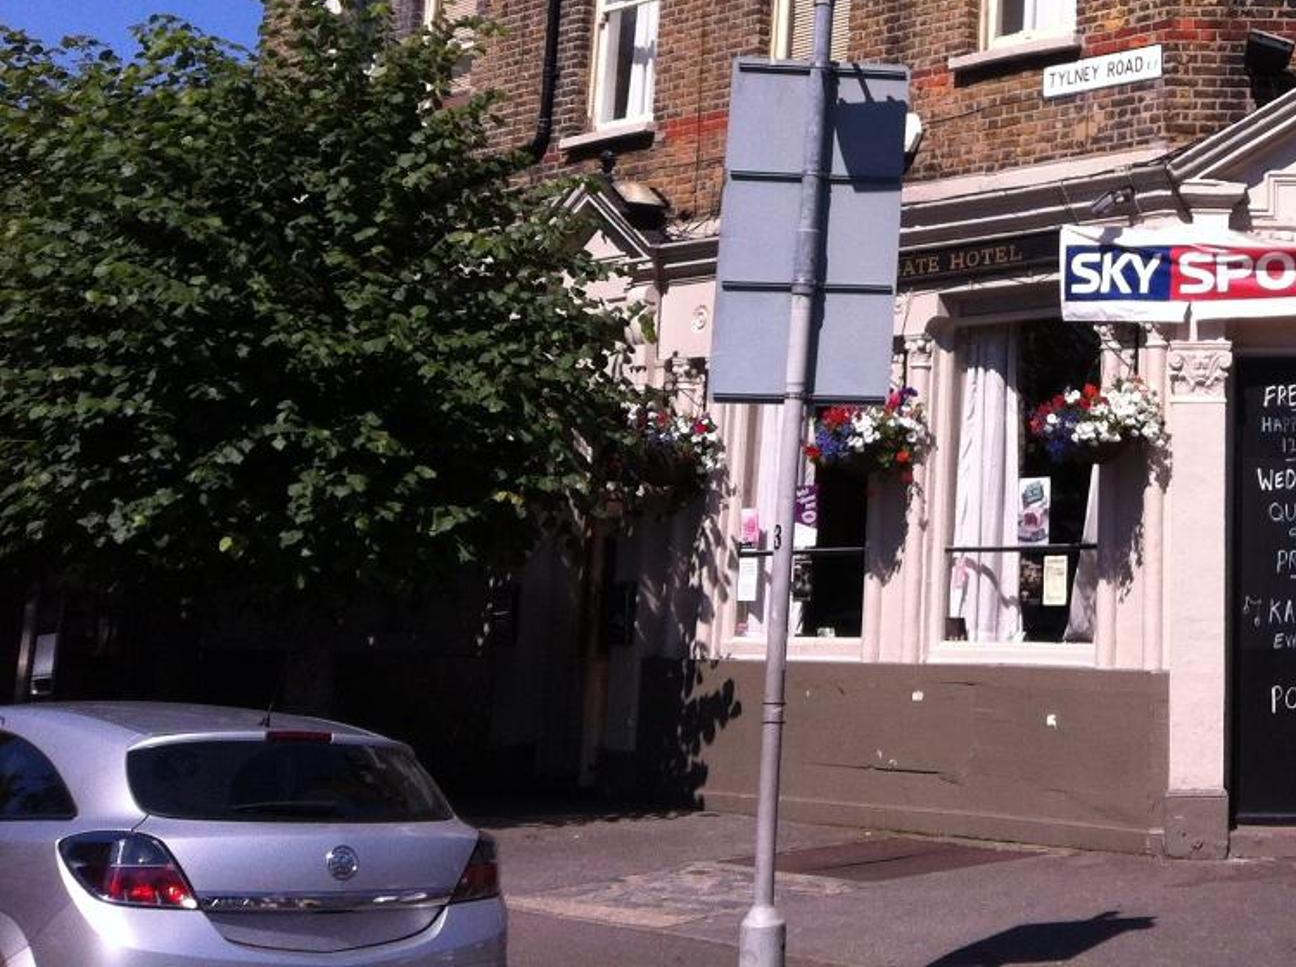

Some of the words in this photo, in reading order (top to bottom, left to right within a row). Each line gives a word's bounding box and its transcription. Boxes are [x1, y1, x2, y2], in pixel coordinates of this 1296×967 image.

[1048, 65, 1100, 89] TYLNEY
[1106, 55, 1143, 78] ROAD
[903, 256, 940, 276] ATE
[950, 245, 1023, 270] HOTEL
[1070, 252, 1162, 295] SKY
